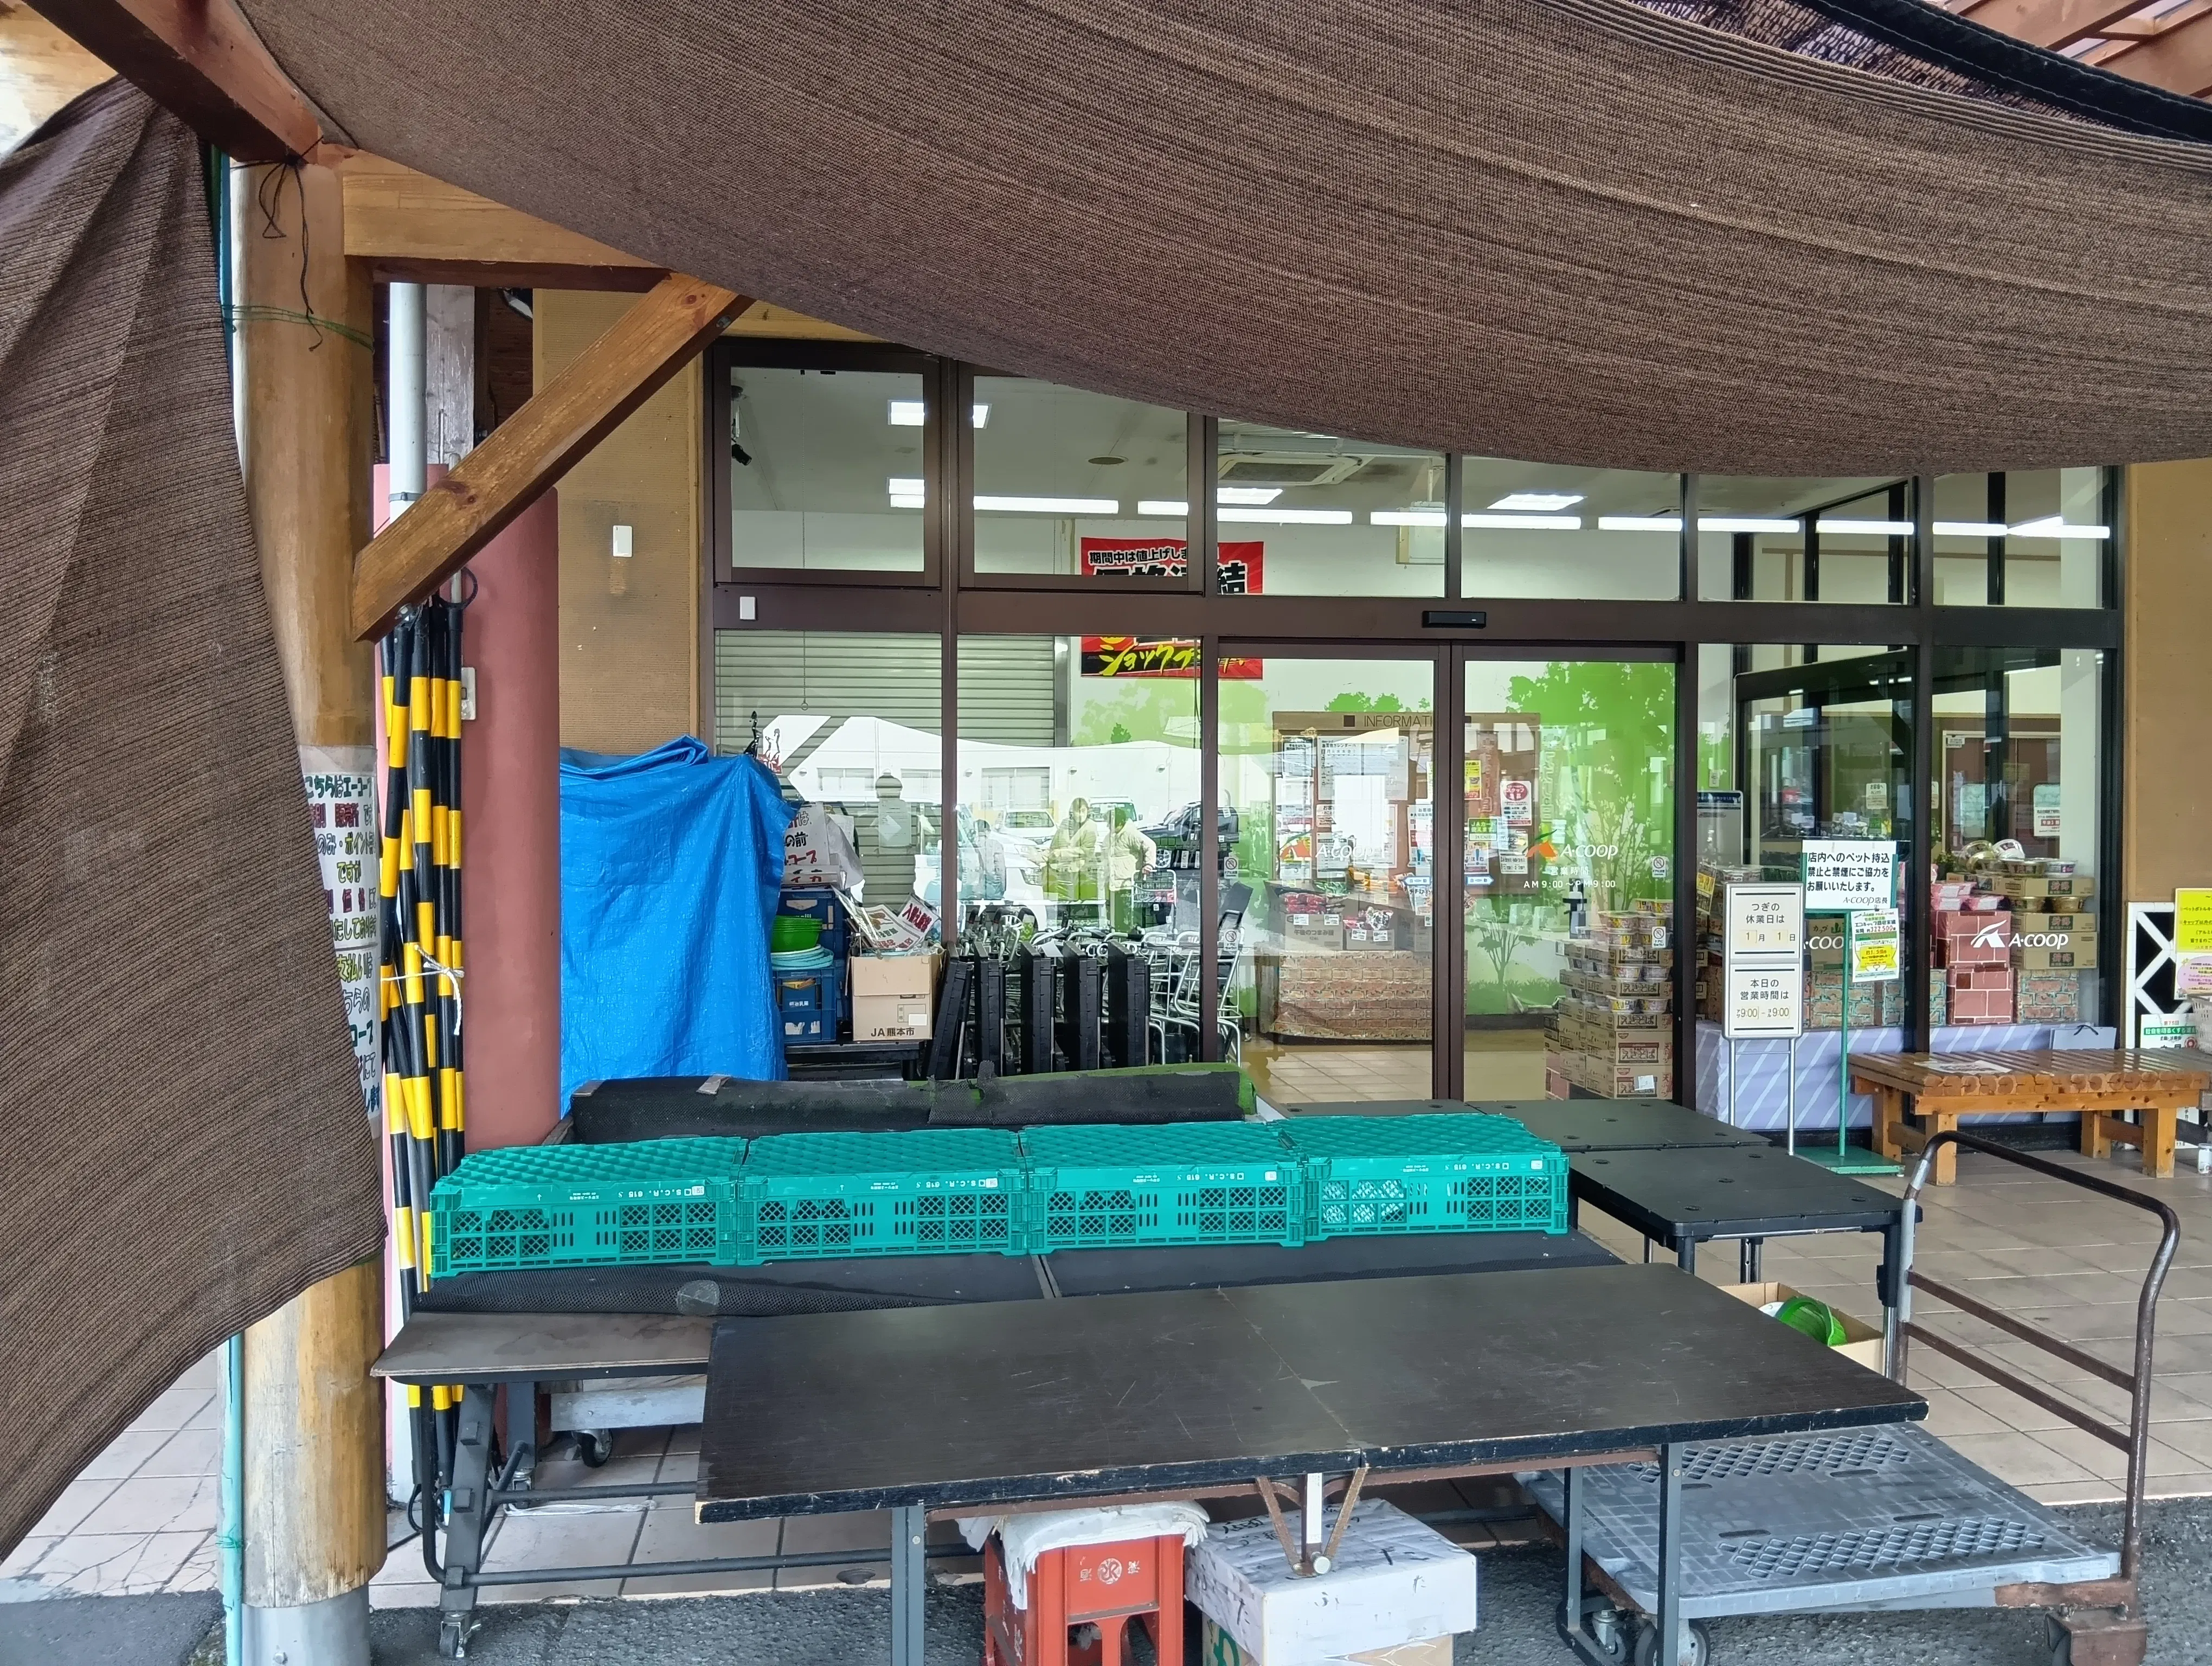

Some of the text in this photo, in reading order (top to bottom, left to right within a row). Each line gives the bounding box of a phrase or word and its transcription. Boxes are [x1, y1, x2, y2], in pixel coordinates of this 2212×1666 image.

[1808, 852, 1890, 863] 店内へのペット持込
[1550, 866, 1589, 875] 営業時間
[1808, 866, 1889, 877] 禁止と禁煙にご協力を
[1807, 881, 1875, 892] お願いいたします。
[1751, 902, 1780, 912] つぎの
[1746, 914, 1785, 924] 休業日は
[1750, 978, 1779, 988] 本日の
[1740, 990, 1789, 1000] 営業時間は
